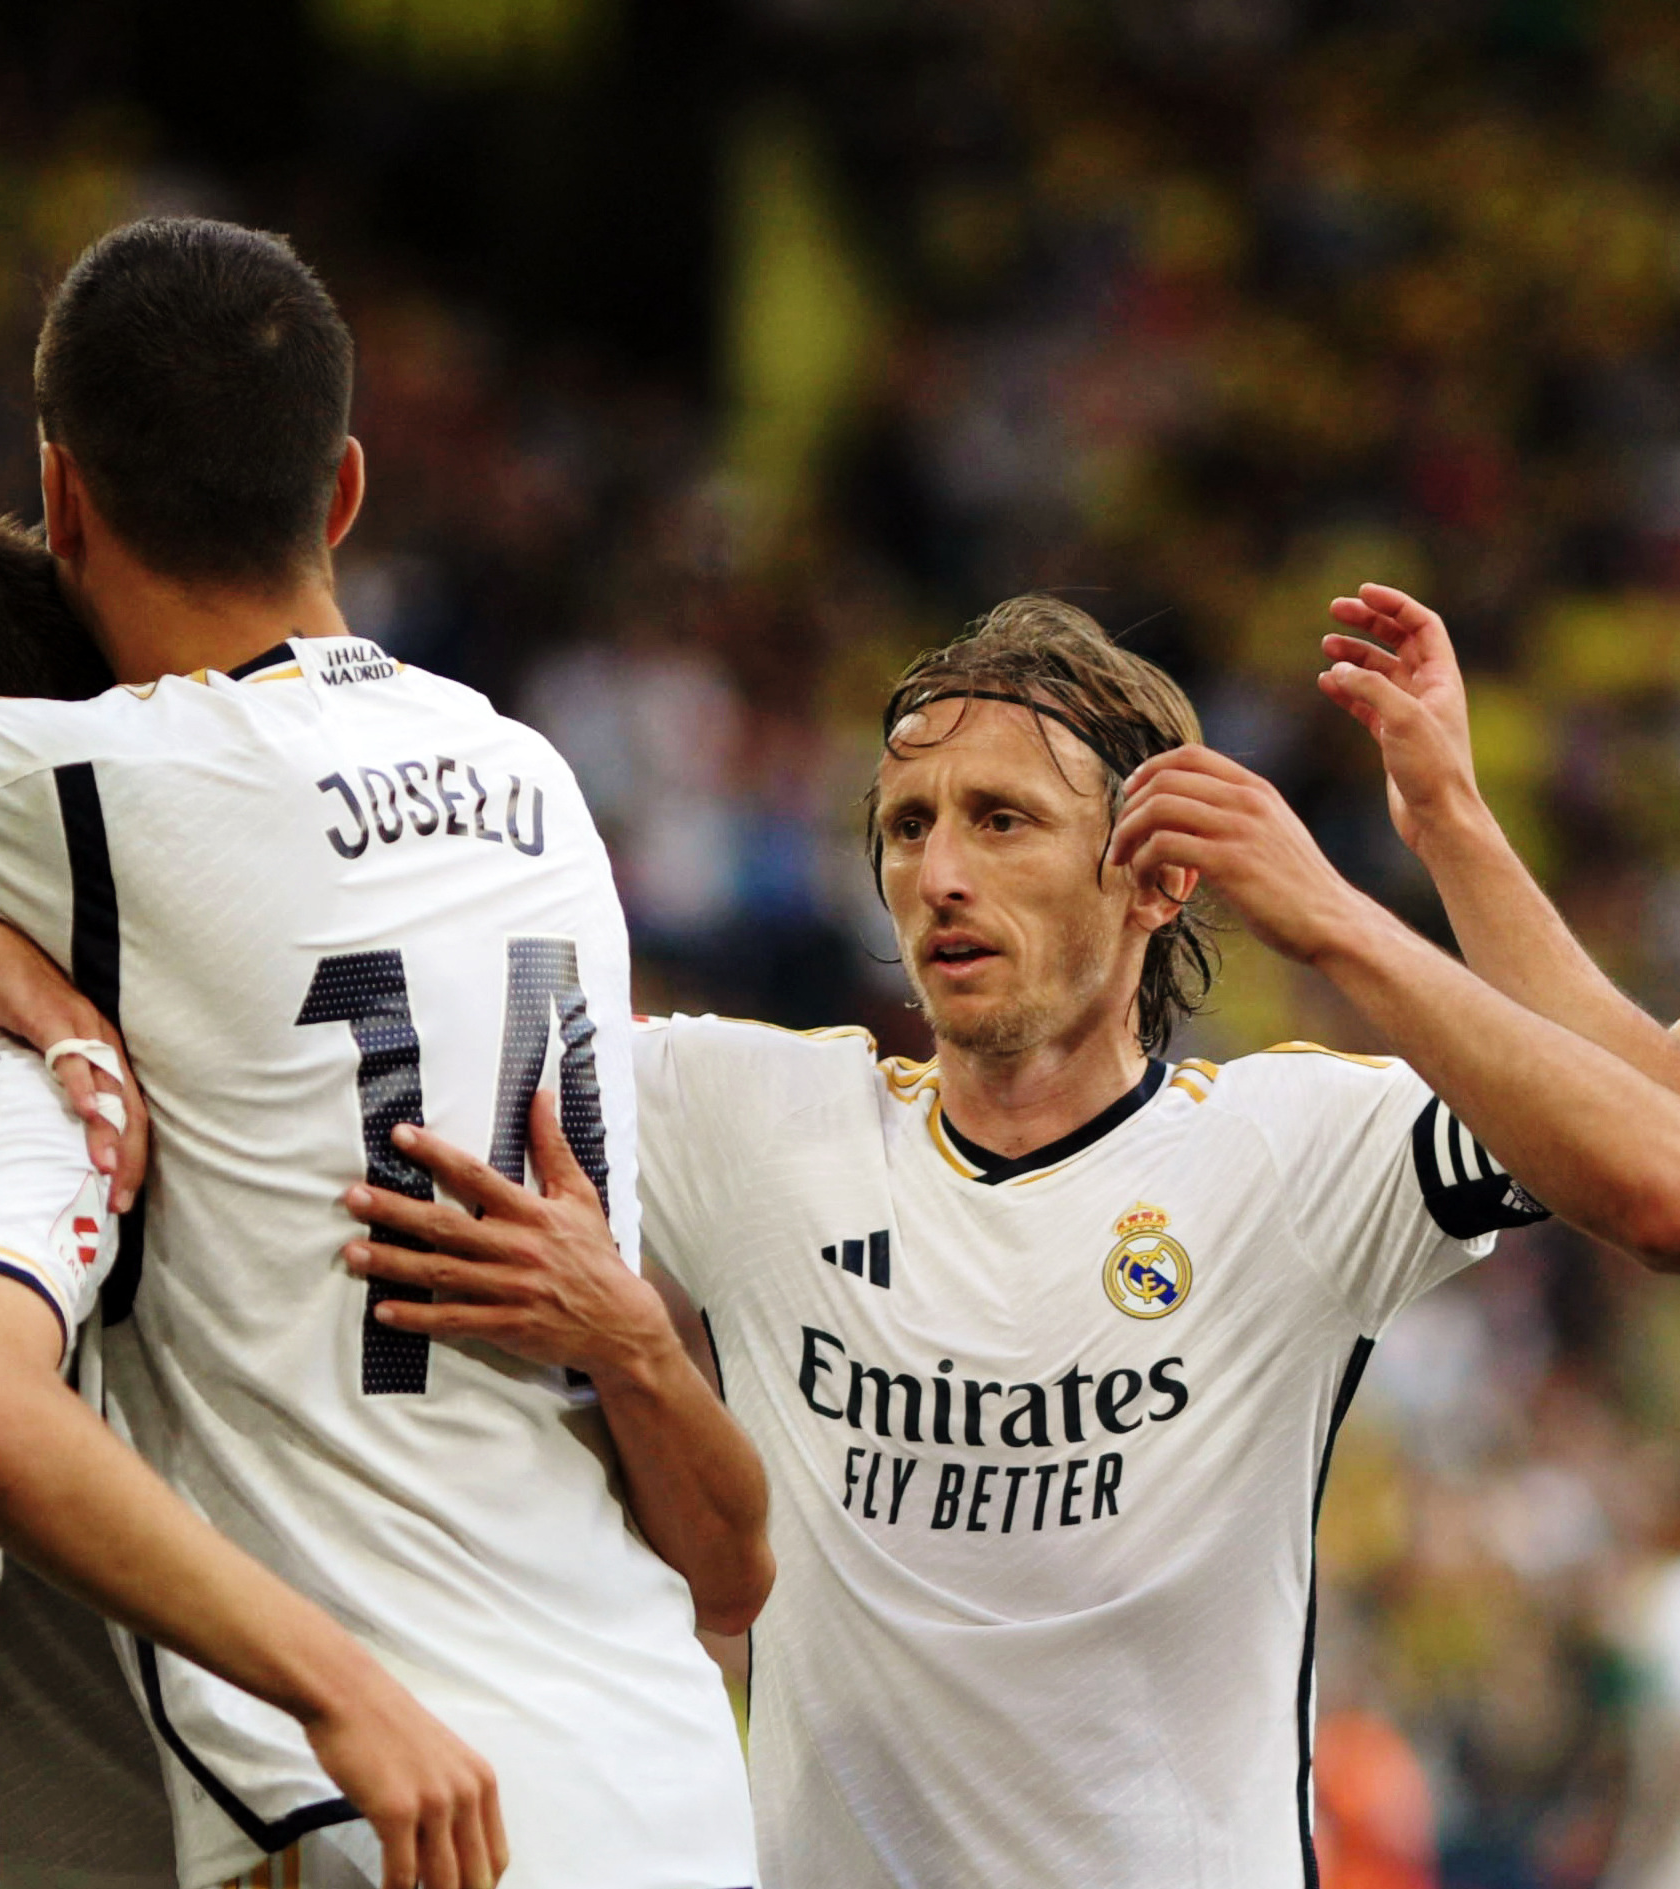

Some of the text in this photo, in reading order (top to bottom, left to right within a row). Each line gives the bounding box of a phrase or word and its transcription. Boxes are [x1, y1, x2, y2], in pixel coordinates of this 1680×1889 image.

[319, 661, 394, 686] MADRID
[314, 753, 545, 860] JOSELU
[798, 1324, 1190, 1448] Emirates
[842, 1446, 1124, 1534] FLY BETTER
